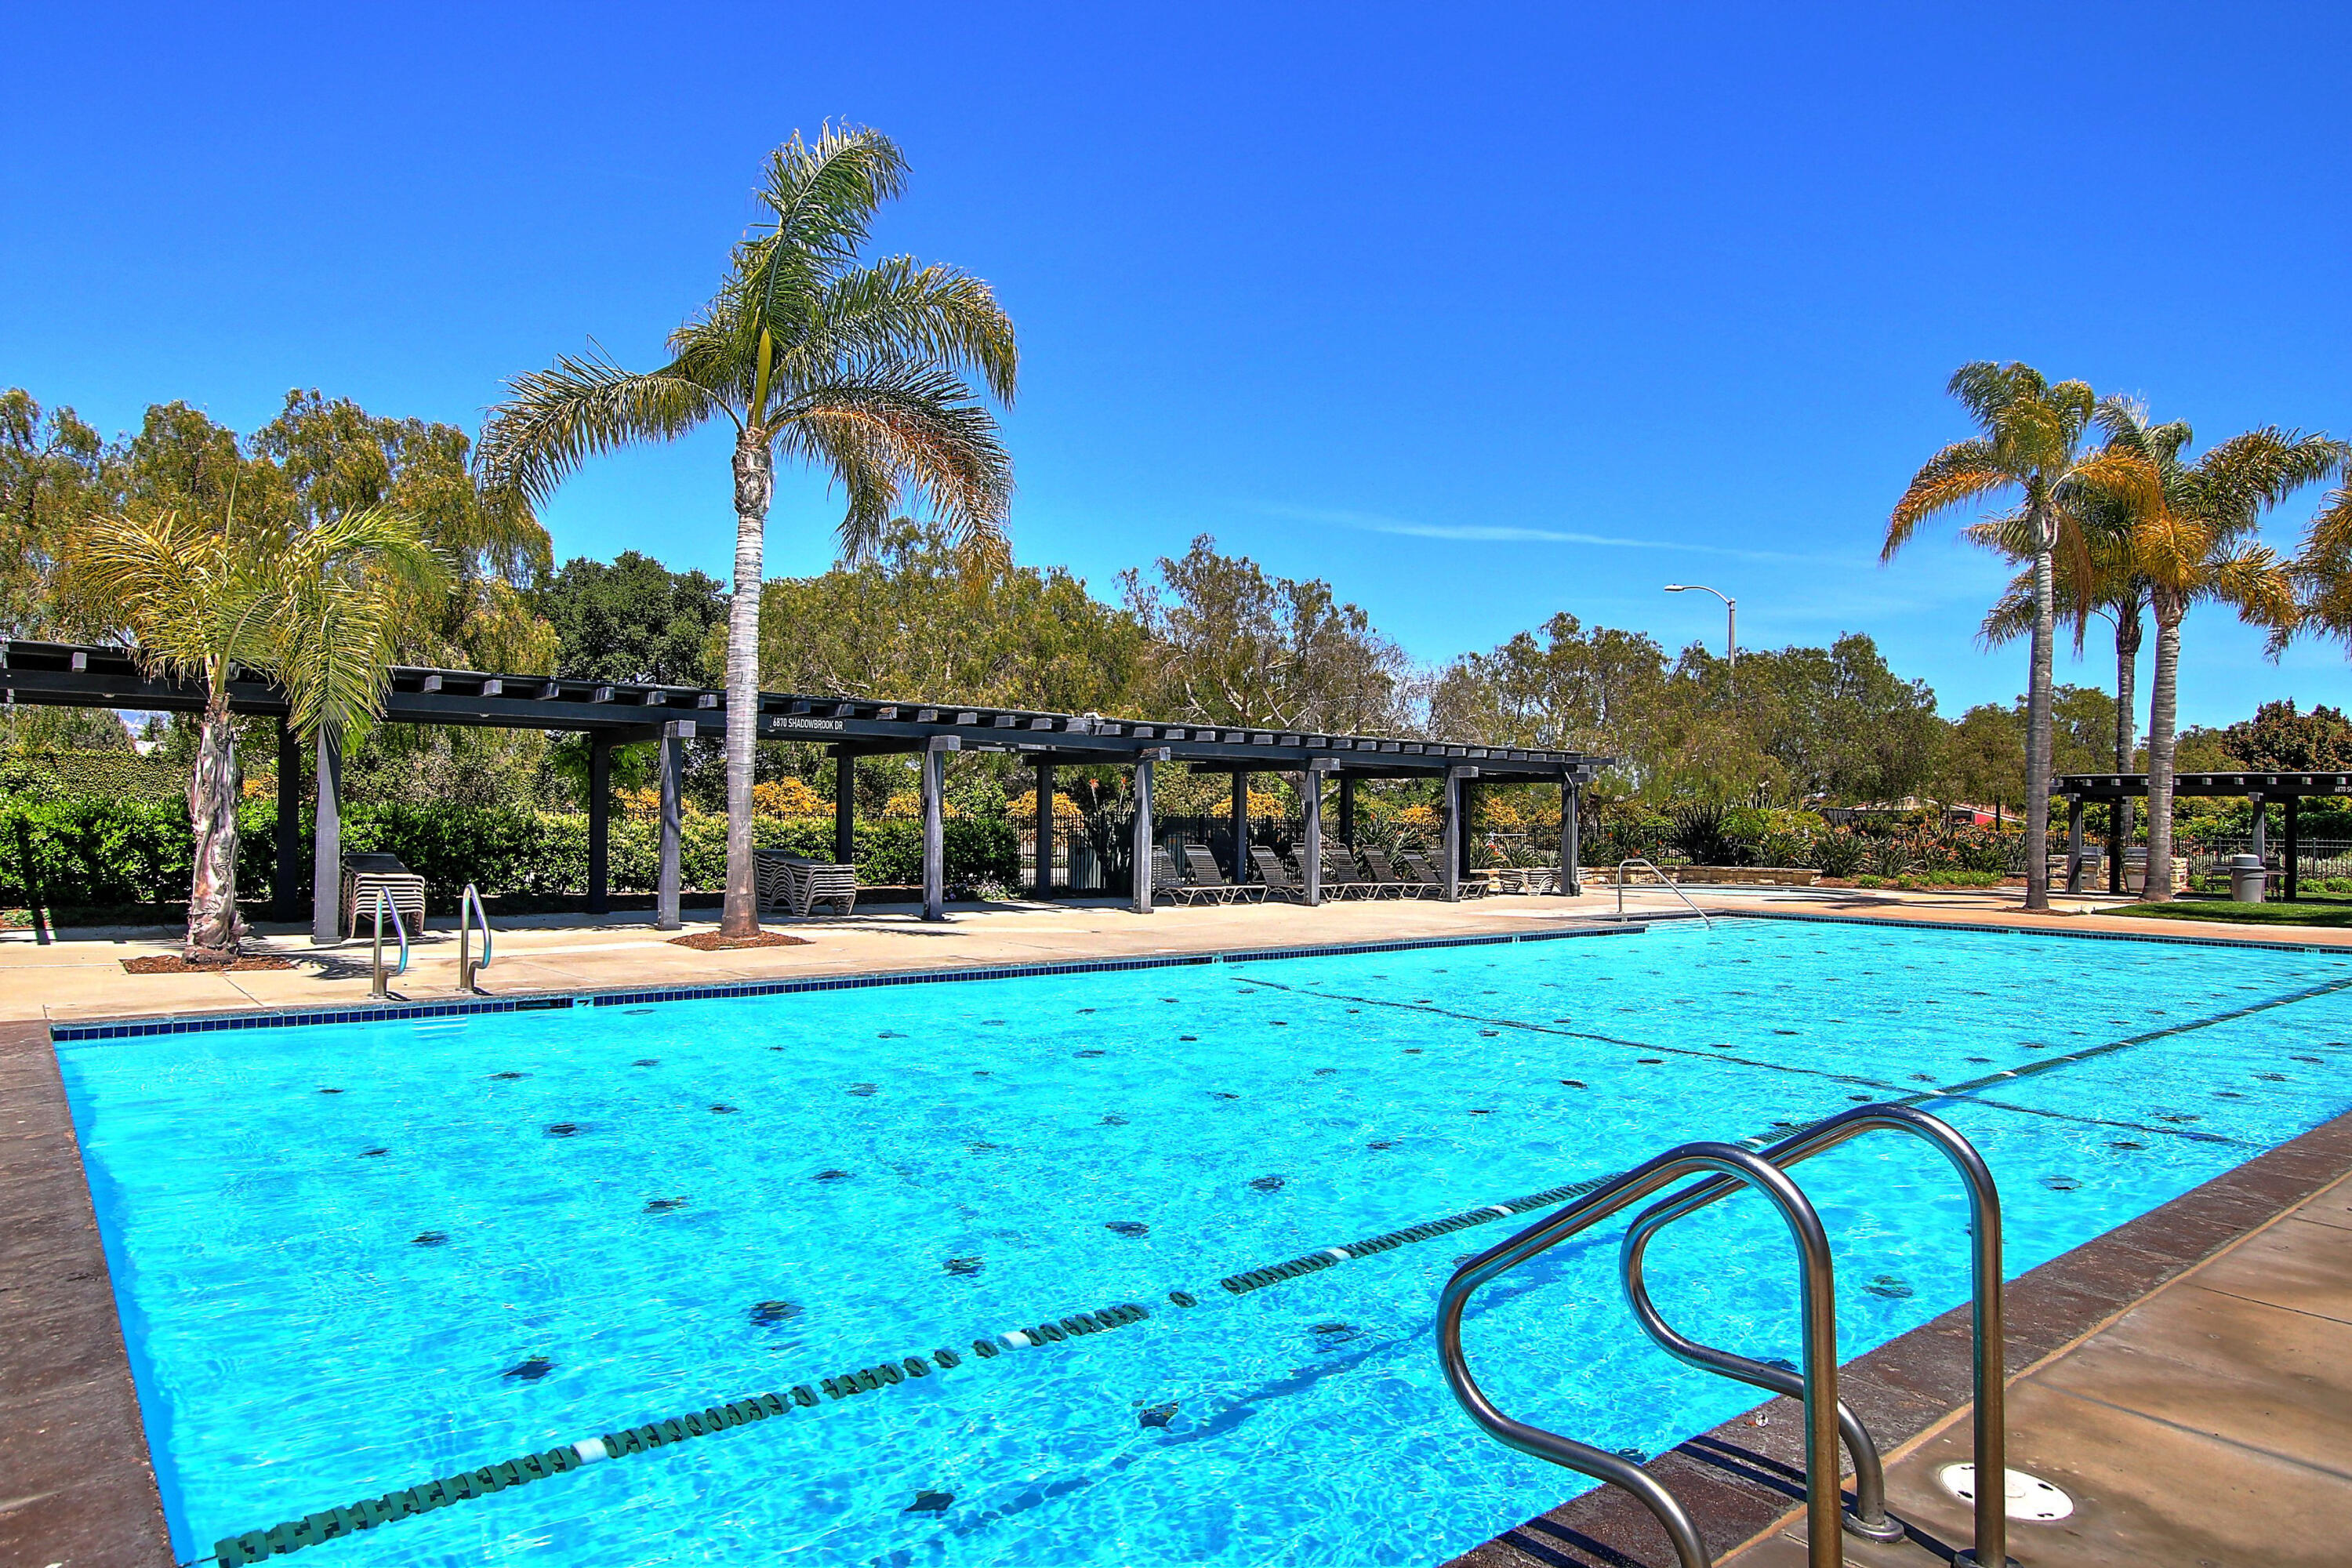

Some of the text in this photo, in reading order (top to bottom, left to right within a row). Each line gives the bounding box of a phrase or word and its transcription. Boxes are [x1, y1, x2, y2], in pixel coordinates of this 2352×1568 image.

[772, 717, 844, 731] 6870 SHADOWBROOK DR
